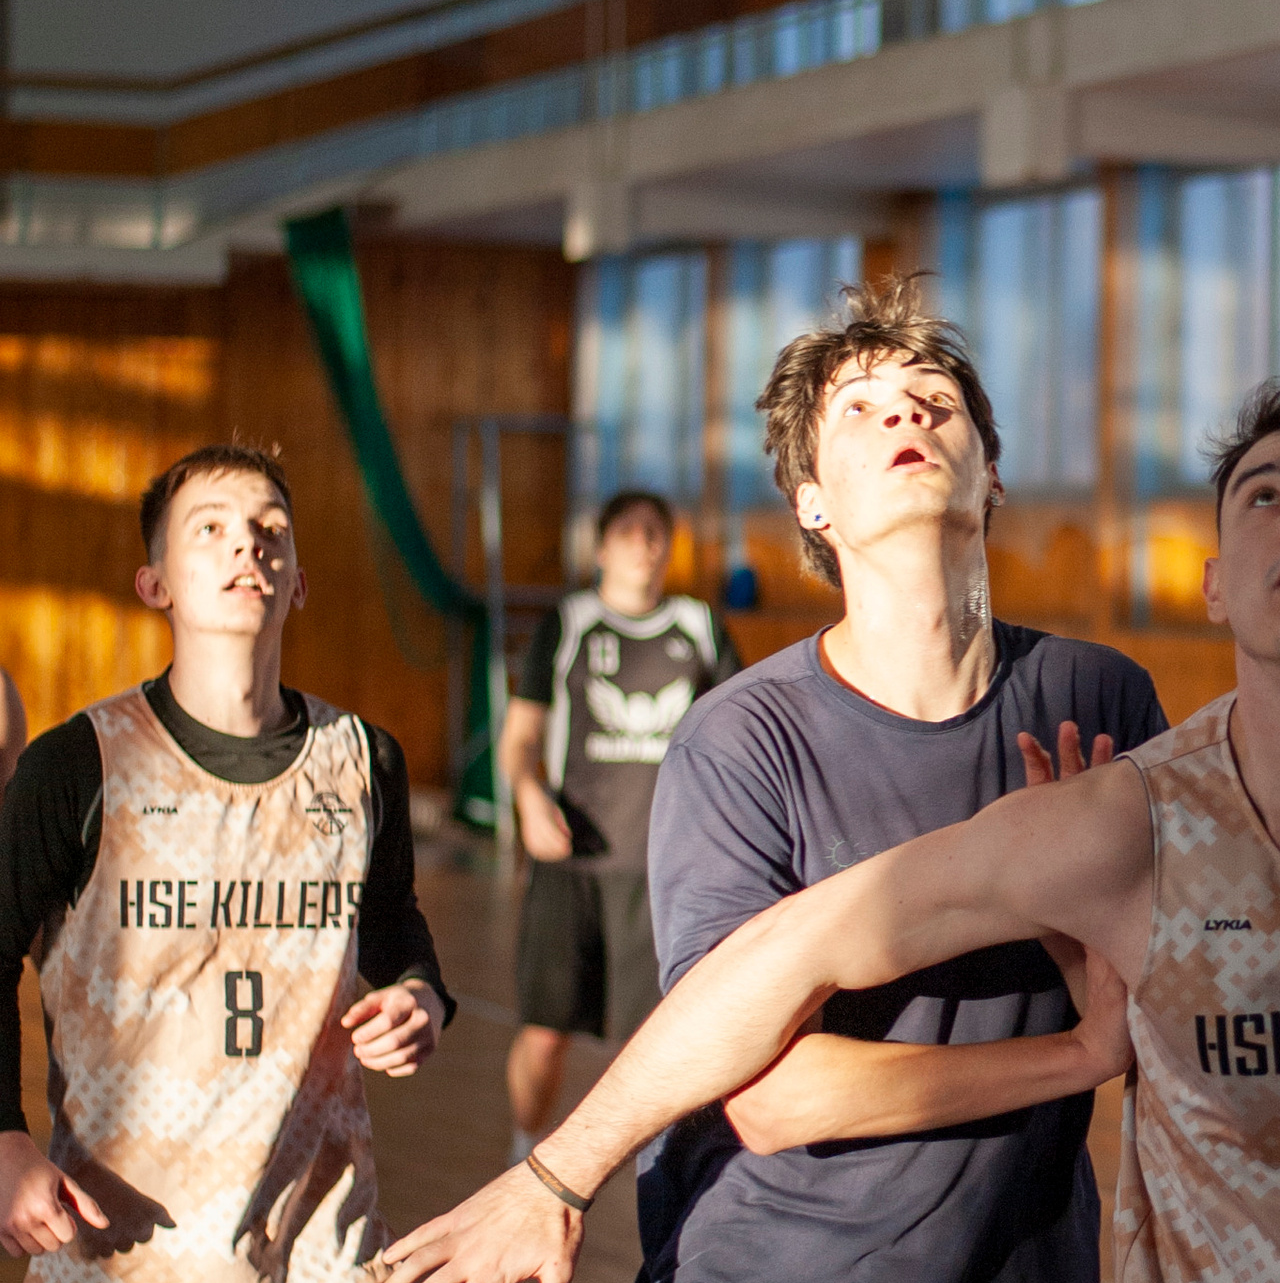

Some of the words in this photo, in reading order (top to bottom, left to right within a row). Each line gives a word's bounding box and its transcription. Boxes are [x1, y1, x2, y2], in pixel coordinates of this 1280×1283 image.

[119, 880, 199, 929] HSE
[210, 880, 364, 929] KILLERS
[1204, 919, 1252, 931] LYKIA
[224, 971, 264, 1058] 8
